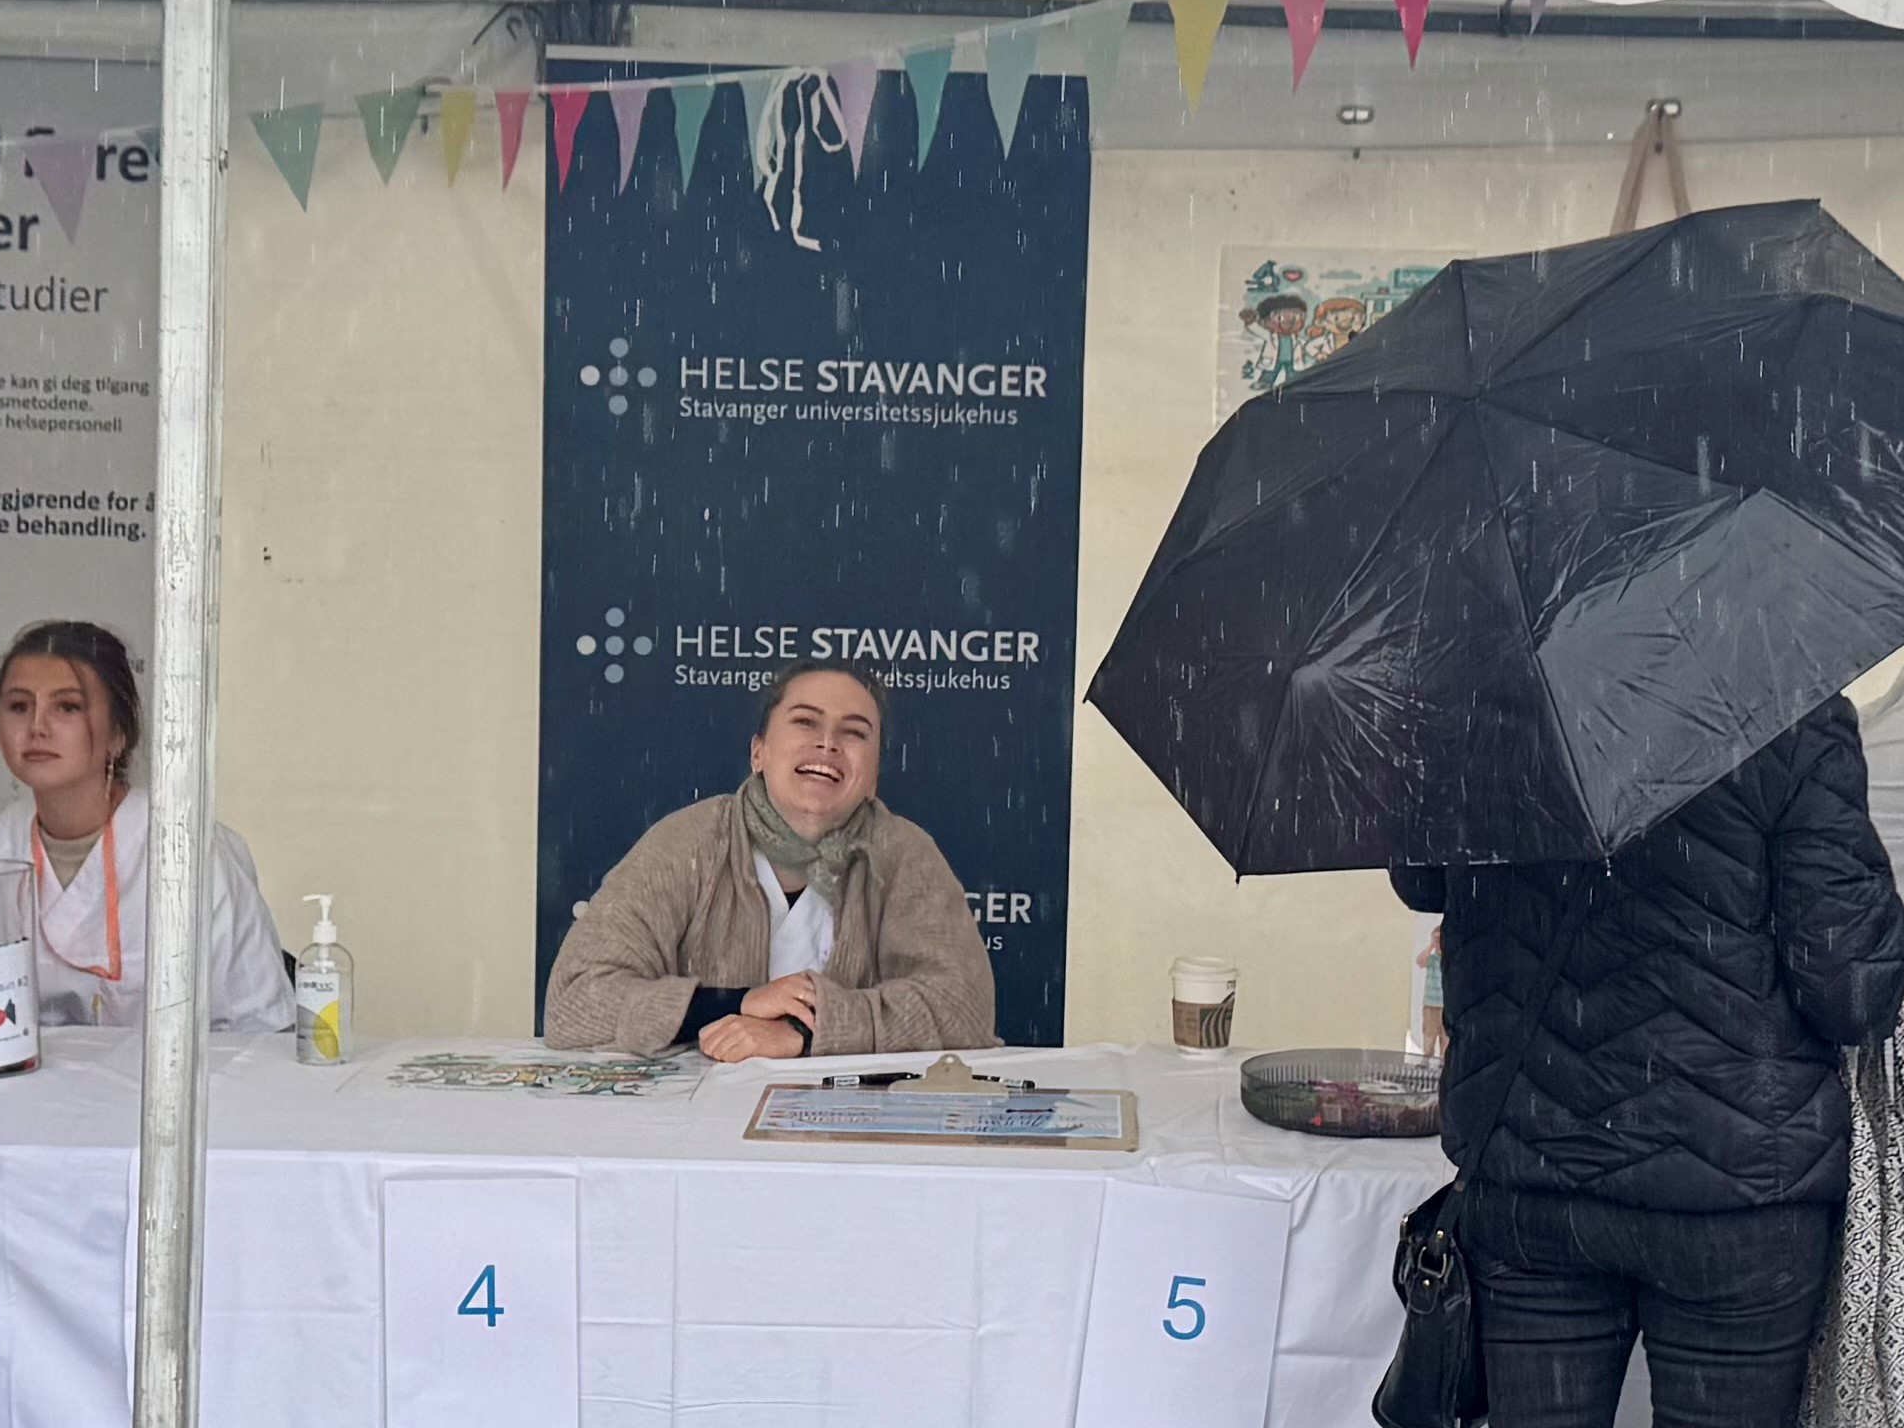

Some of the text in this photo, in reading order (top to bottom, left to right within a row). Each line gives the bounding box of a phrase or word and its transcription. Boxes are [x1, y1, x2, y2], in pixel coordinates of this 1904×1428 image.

[11, 373, 39, 390] kan
[42, 374, 58, 394] gi
[61, 375, 92, 395] deg
[95, 375, 150, 397] tilgang
[680, 356, 1048, 398] HELSE STAVANGER
[5, 413, 123, 435] helsepersonell
[679, 395, 1019, 429] Stavanger universitetssjukehus
[107, 491, 139, 512] for
[16, 513, 148, 542] behandling.
[675, 624, 1041, 664] HELSE STAVANGER
[456, 1264, 506, 1329] 4
[1161, 1273, 1208, 1341] 5
